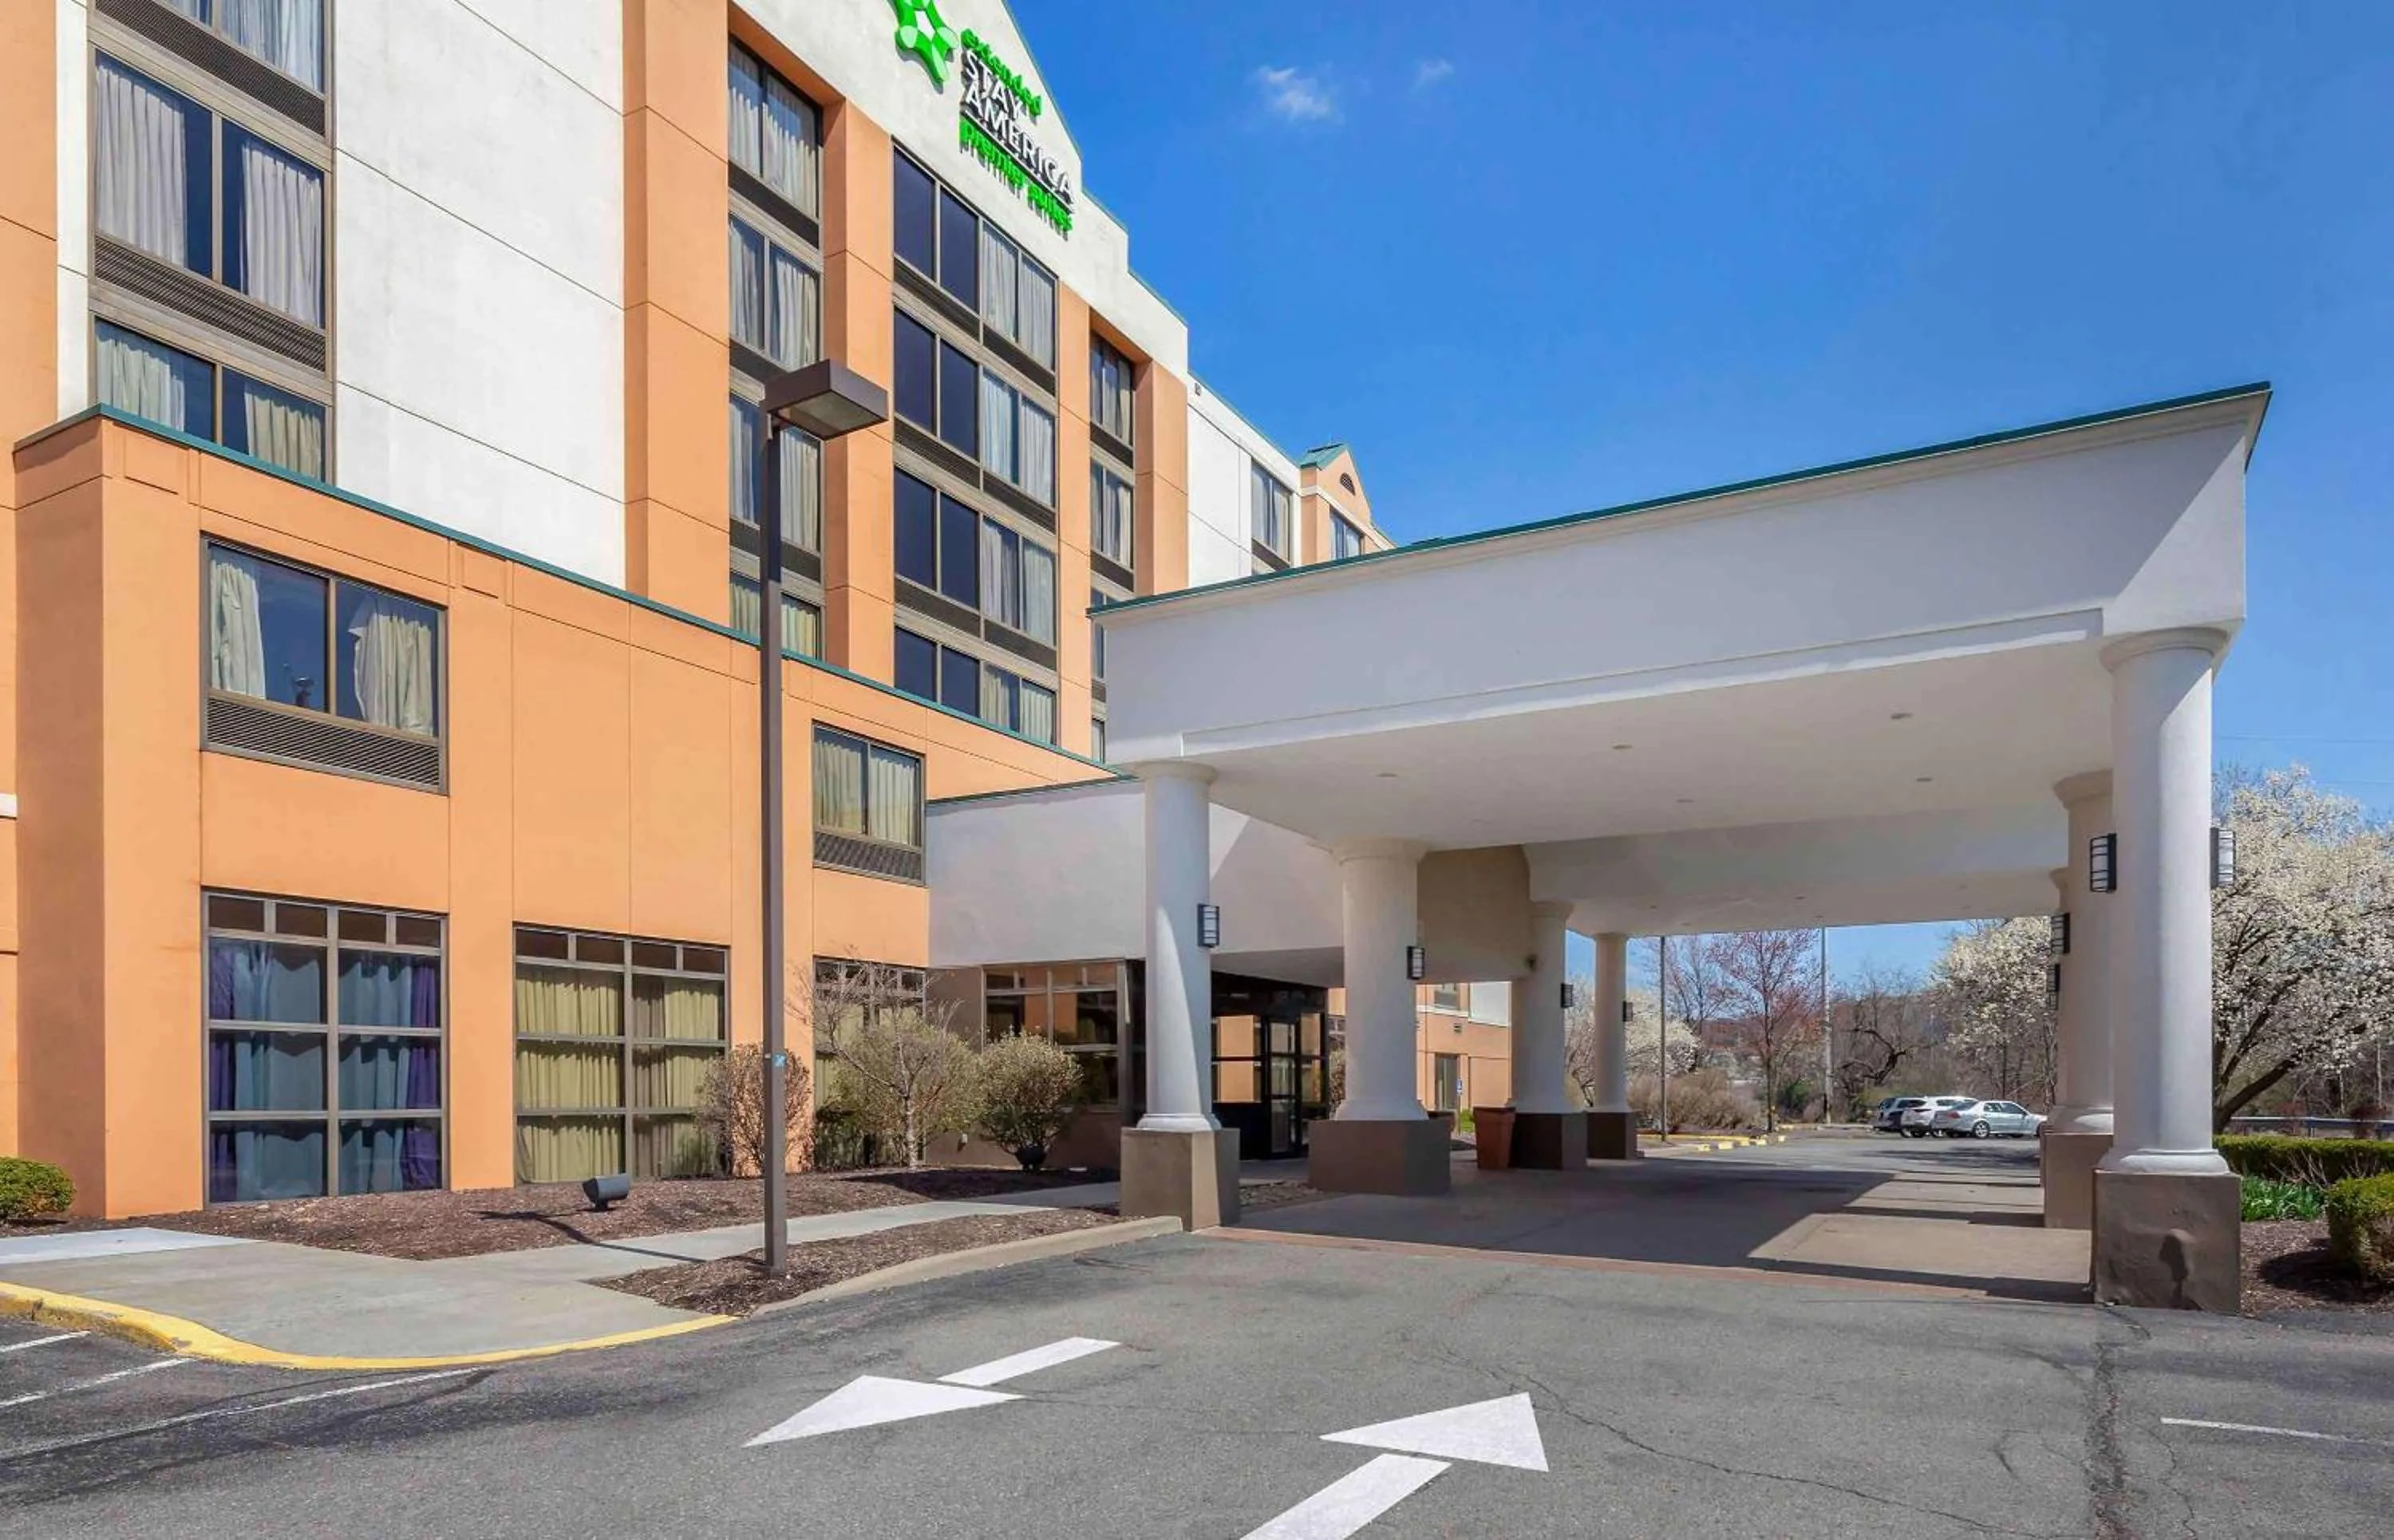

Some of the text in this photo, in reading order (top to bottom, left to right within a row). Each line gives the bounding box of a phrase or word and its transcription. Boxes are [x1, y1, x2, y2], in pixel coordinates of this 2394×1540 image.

[960, 29, 1042, 116] extended
[962, 49, 1026, 119] STAY
[962, 80, 1075, 206] AMERICA
